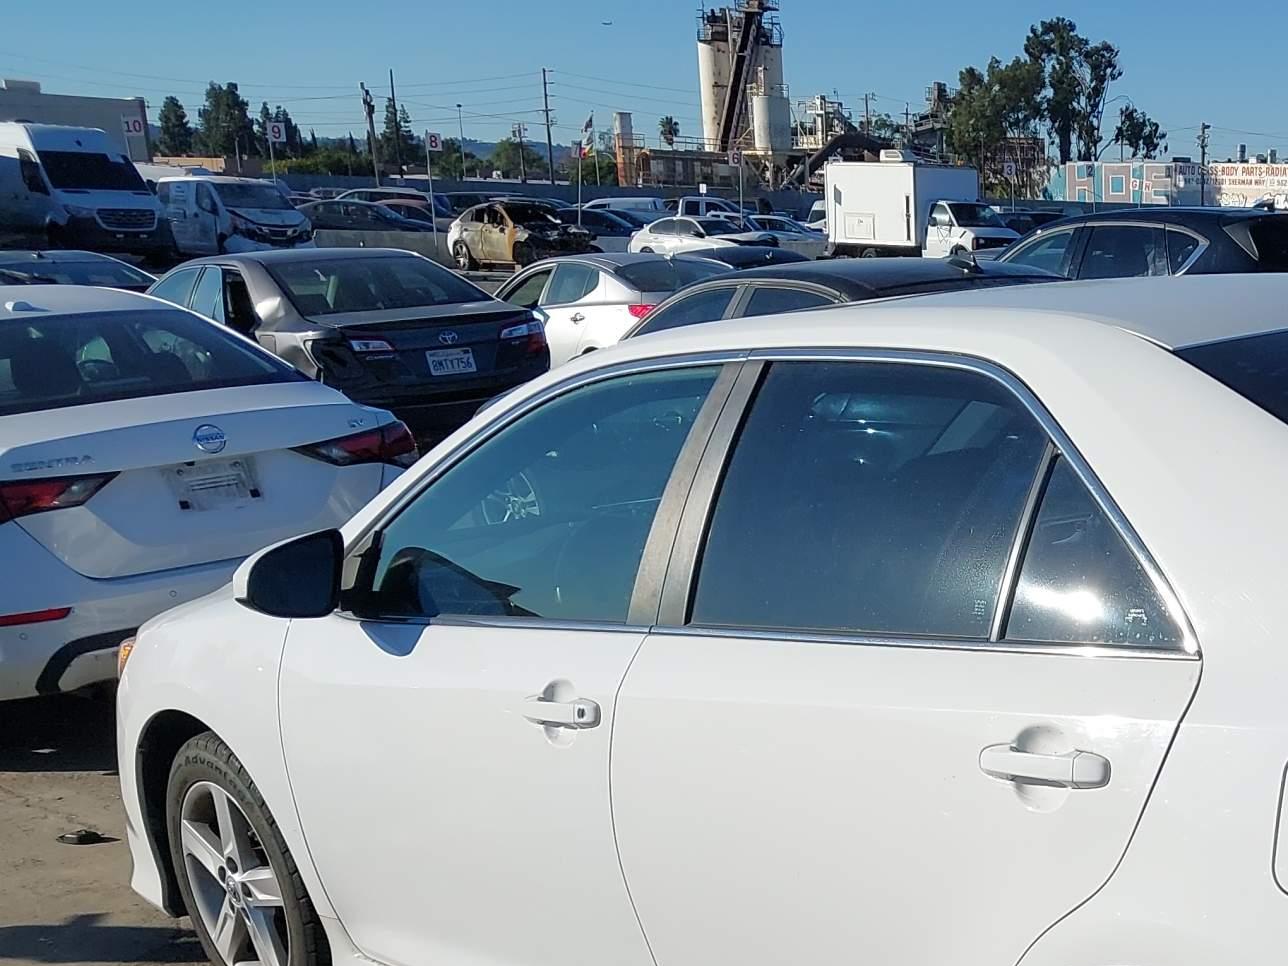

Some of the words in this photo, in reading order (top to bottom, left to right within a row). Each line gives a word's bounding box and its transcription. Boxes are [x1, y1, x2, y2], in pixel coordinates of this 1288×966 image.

[124, 119, 141, 133] 10
[271, 125, 281, 139] 9
[429, 135, 438, 149] 8
[732, 152, 740, 165] 6
[1006, 165, 1013, 176] 3
[1178, 165, 1196, 176] AUTO
[10, 454, 96, 473] SENTRA
